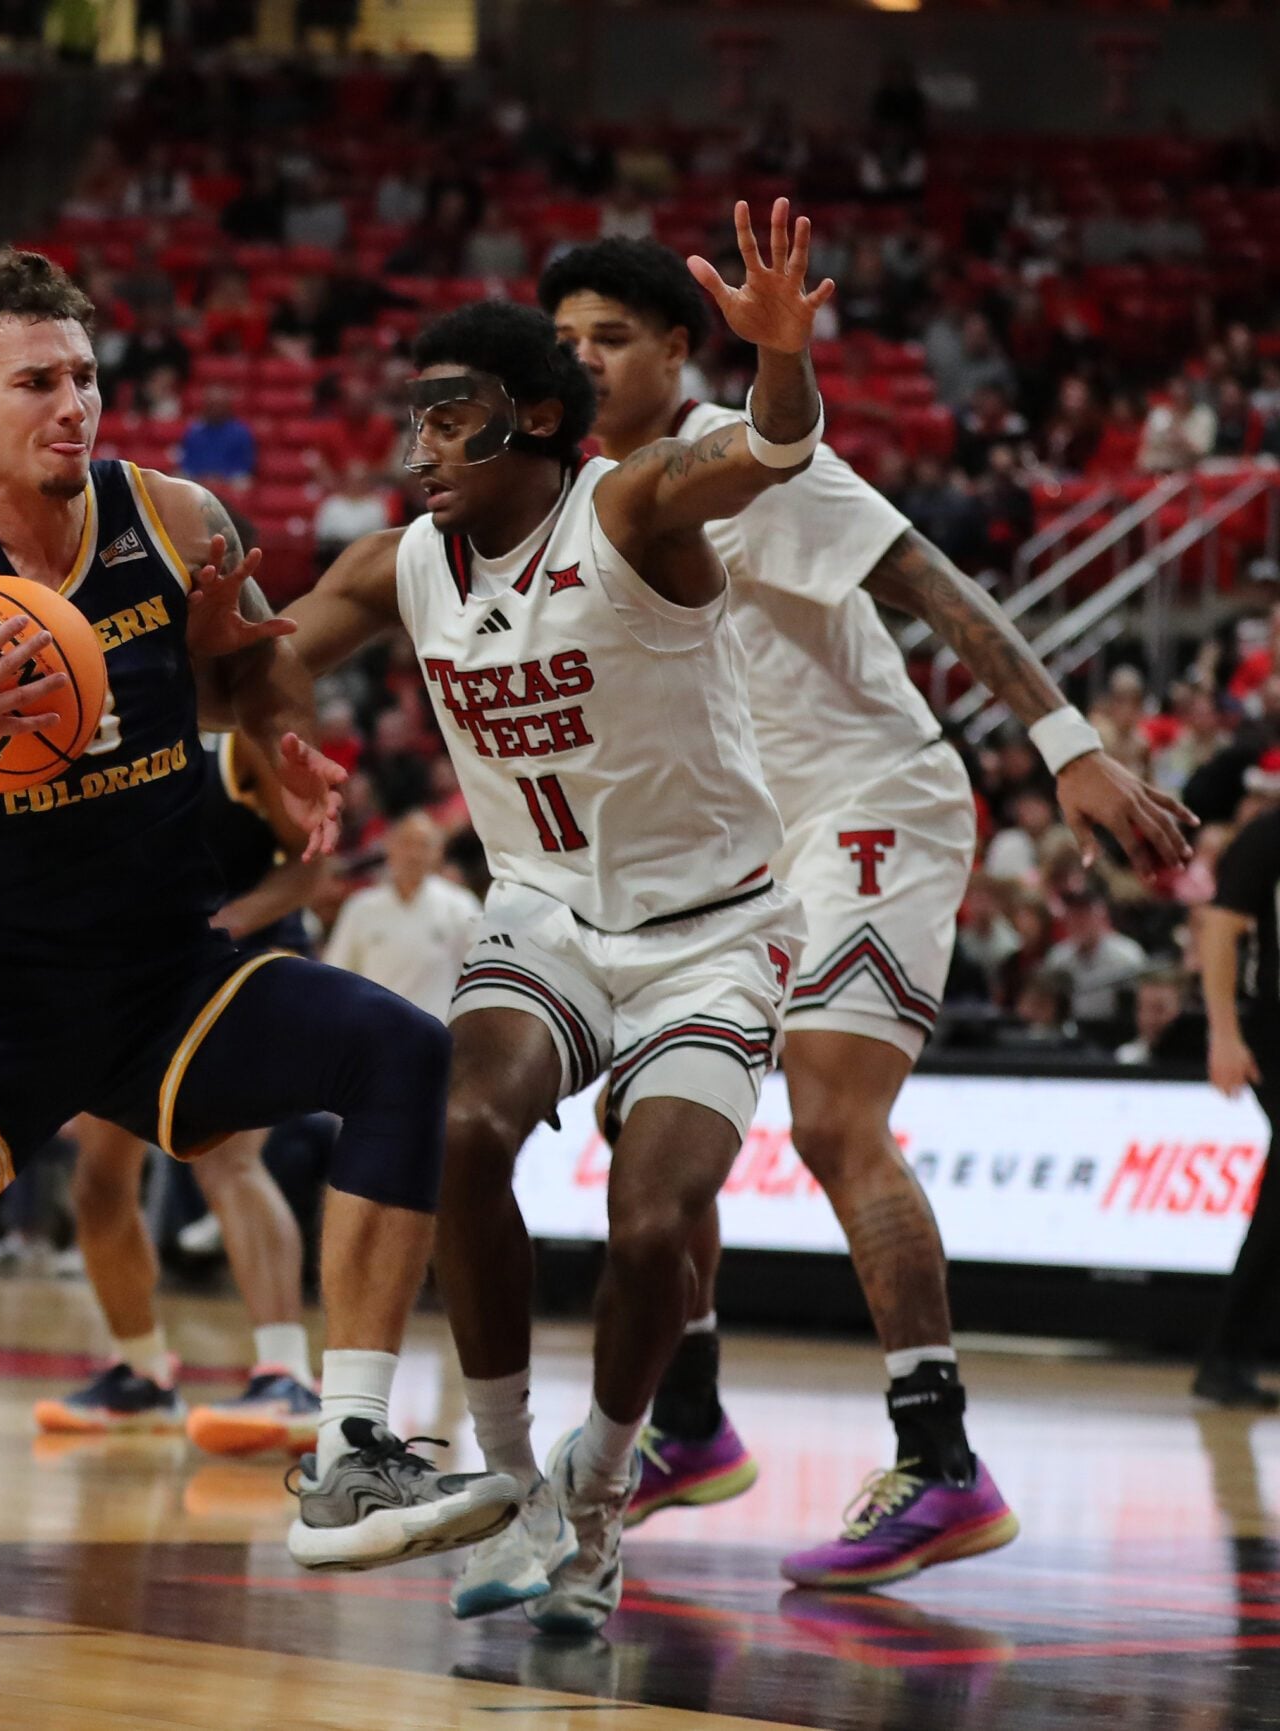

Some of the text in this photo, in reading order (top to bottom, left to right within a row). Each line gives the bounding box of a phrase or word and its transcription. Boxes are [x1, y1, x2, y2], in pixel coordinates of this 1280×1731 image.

[424, 648, 596, 711] TEXAS
[451, 705, 595, 759] TECH
[3, 738, 189, 816] COLORADO
[515, 773, 590, 853] 11
[1101, 1139, 1268, 1222] MISS
